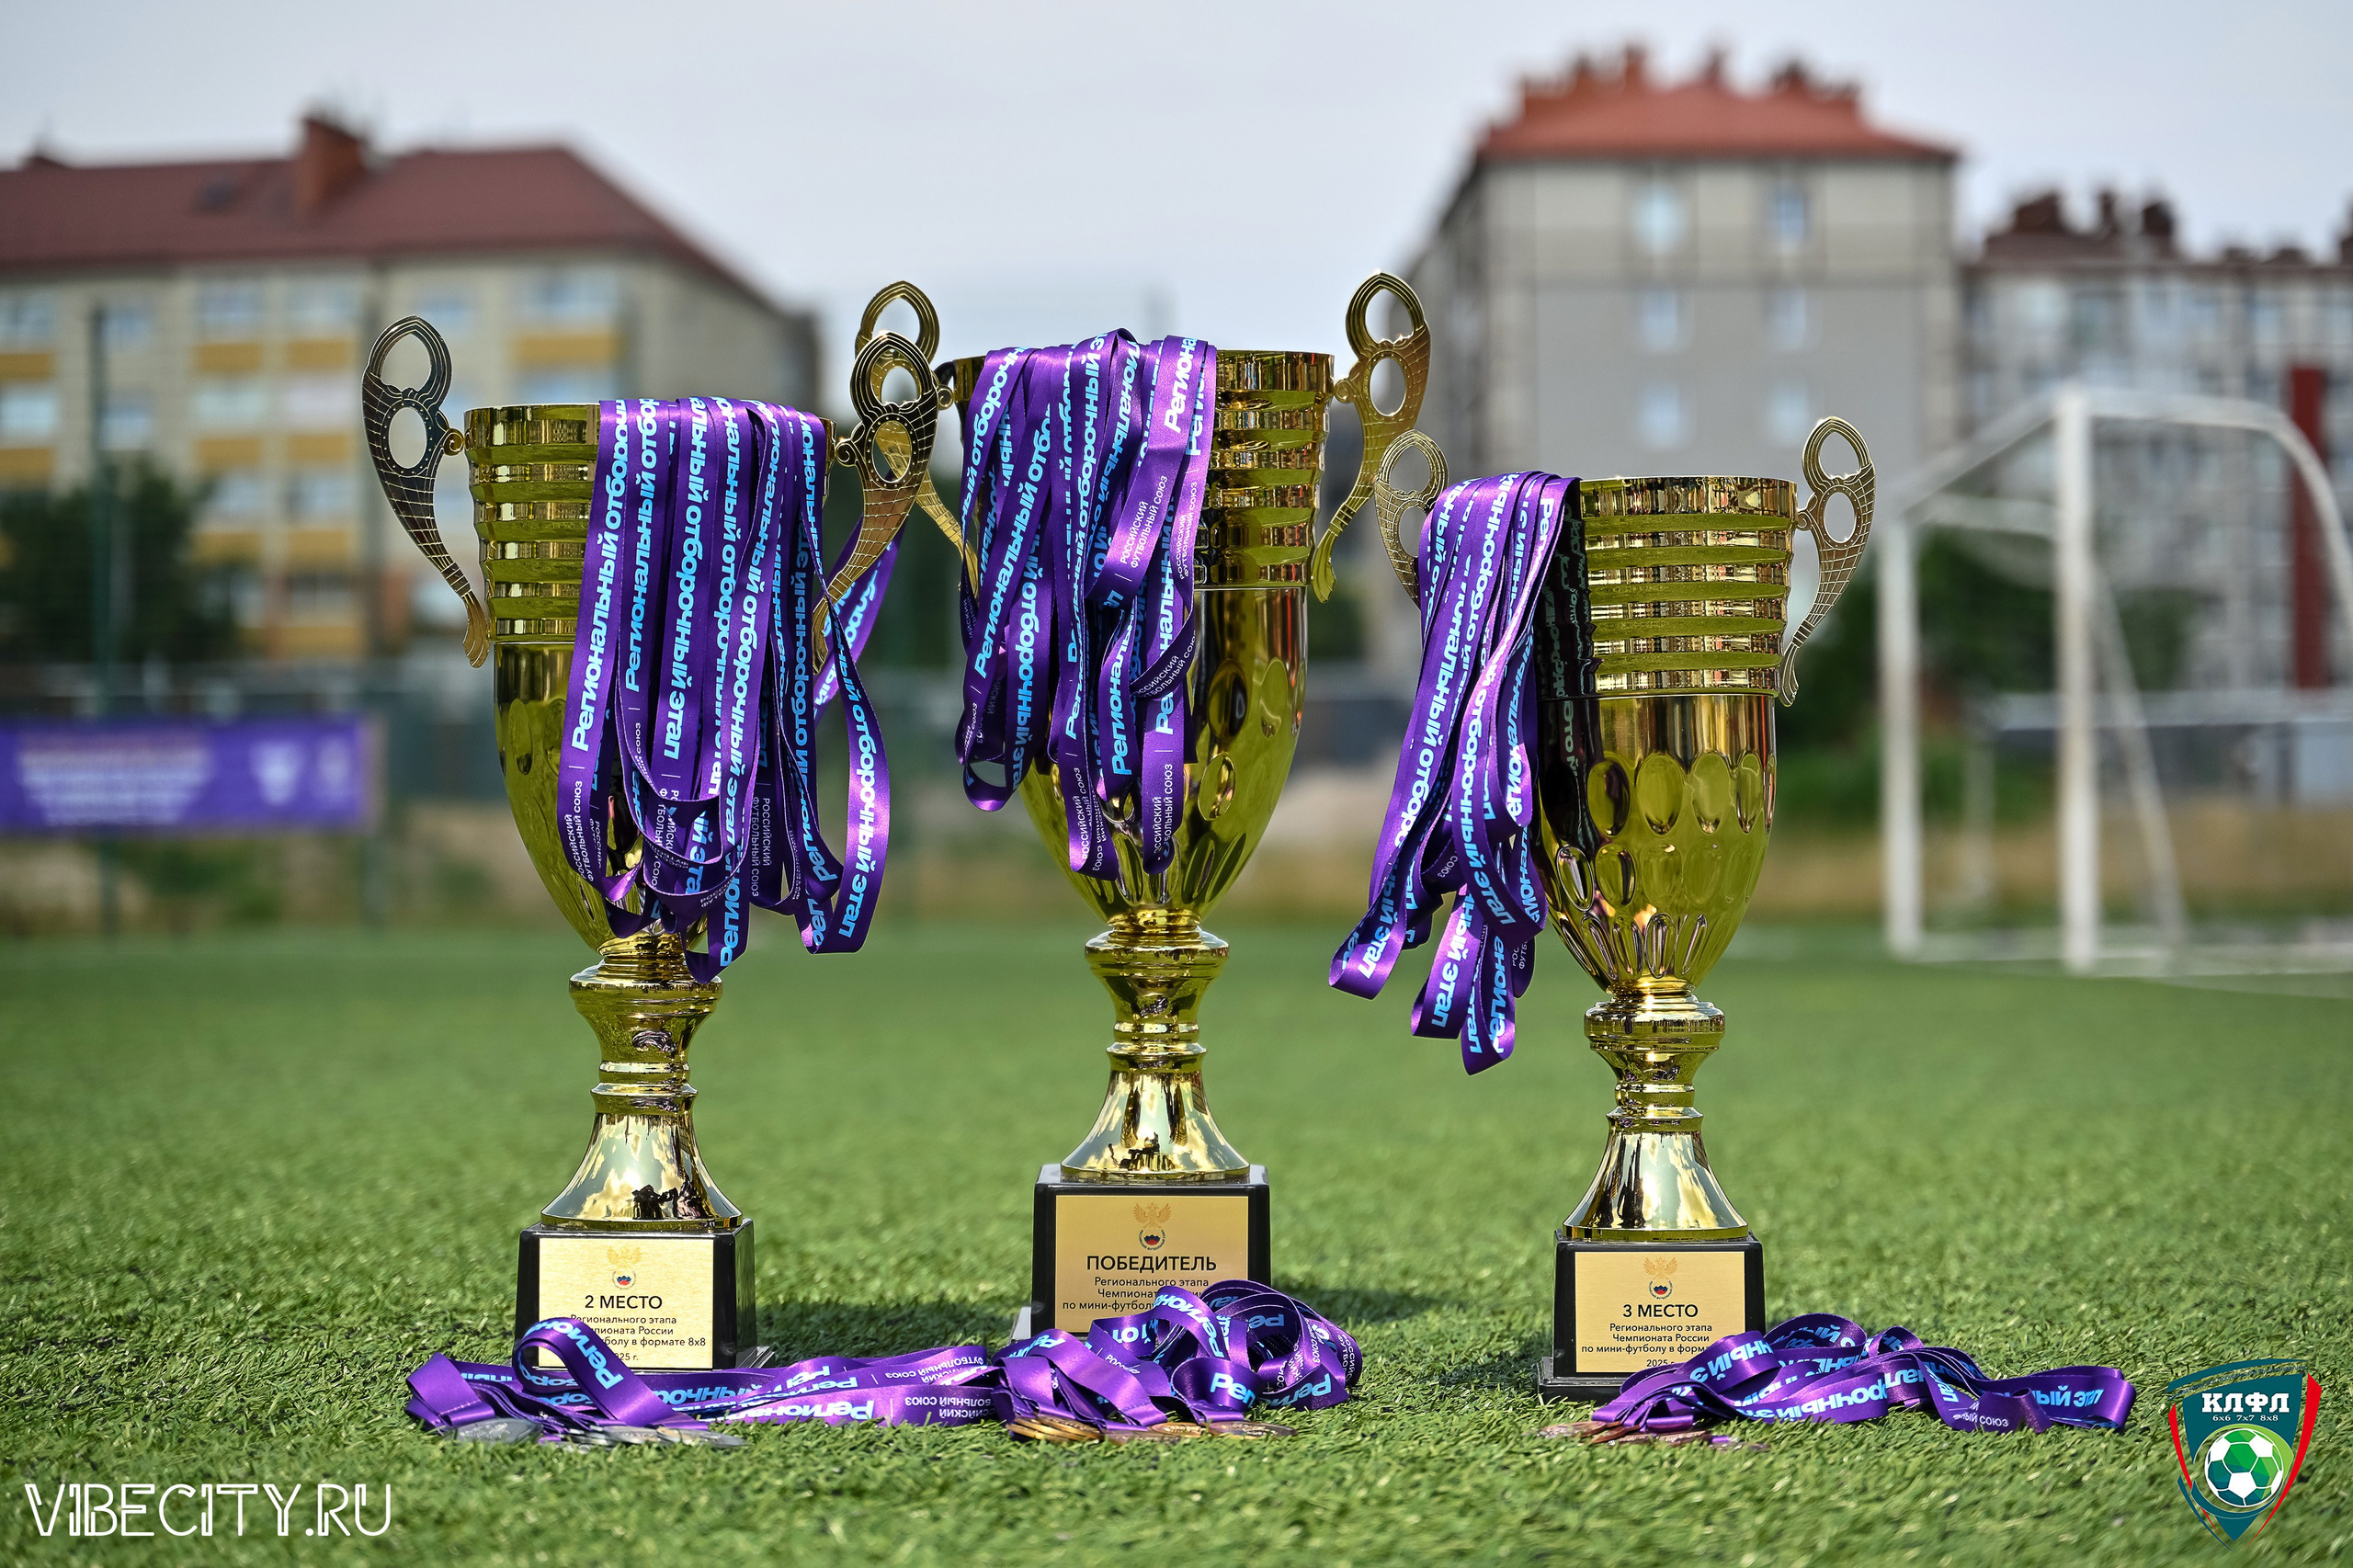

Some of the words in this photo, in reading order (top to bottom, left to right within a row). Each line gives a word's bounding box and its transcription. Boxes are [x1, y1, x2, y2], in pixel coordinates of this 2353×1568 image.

[1165, 338, 1198, 434] Региона
[1078, 352, 1101, 528] отборочный
[1120, 501, 1148, 564] РОССИЙСКИЙ
[1131, 505, 1159, 568] ФУТБОЛЬНЫЙ
[1154, 475, 1167, 505] СОЮЗ
[1181, 511, 1195, 577] ФУТБОЛЬНЫЙ
[1176, 515, 1187, 580] РОССИЙСКИЙ
[1466, 472, 1520, 642] отборочный
[626, 471, 657, 692] Региональный
[671, 505, 703, 689] отборочный
[974, 482, 1039, 679] Региональный
[572, 530, 620, 752] Региональный
[790, 572, 810, 746] отборочный
[1014, 582, 1040, 744] отборочный
[1184, 631, 1195, 659] СОЮ
[730, 595, 758, 776] отборочный
[664, 690, 686, 760] этап
[1506, 632, 1534, 824] егиональный
[851, 704, 878, 873] отборочный
[1012, 746, 1026, 791] эта
[1074, 767, 1086, 795] СОЮЗ
[1165, 764, 1174, 795] СОЮЗ
[574, 780, 583, 813] СОЮЗ
[725, 777, 739, 846] этап
[1165, 796, 1174, 842] БОЛЬНЫЙ
[1460, 688, 1487, 869] отборочный
[1474, 870, 1517, 926] этап
[751, 797, 760, 867] ФУТБОЛЬНЫЙ
[762, 798, 772, 866] РОССИЙСКИЙ
[1073, 795, 1089, 860] РОССИЙСКИЙ
[1154, 796, 1162, 854] ОССИЙСКИЙ
[1093, 845, 1103, 871] СОЮЗ
[1438, 855, 1459, 878] СОЮЗ
[750, 869, 759, 897] СОЮЗ
[838, 874, 867, 937] этап
[1358, 926, 1391, 980] этап
[1431, 961, 1459, 1028] этап
[1086, 1256, 1217, 1274] ПОБЕДИТЕЛЬ
[1094, 1277, 1176, 1287] Регионального
[1178, 1278, 1209, 1287] этапа
[585, 1295, 595, 1309] 2
[600, 1295, 663, 1310] МЕСТО
[1063, 1301, 1076, 1310] по
[1097, 1289, 1158, 1299] Чемпионат
[1622, 1304, 1632, 1318] 3
[1638, 1304, 1699, 1318] МЕСТО
[638, 1326, 674, 1335] России
[641, 1336, 686, 1348] формате
[1596, 1345, 1666, 1355] мини-футболу
[1677, 1344, 1709, 1355] форм
[1609, 1324, 1684, 1332] Регионального
[1612, 1334, 1673, 1342] Чемпионата
[1676, 1333, 1710, 1342] России
[615, 1353, 631, 1361] 025
[885, 1369, 917, 1379] СОЮЗ
[917, 1356, 983, 1377] ФУТБОЛЬНЫЙ
[1311, 1340, 1321, 1363] СОЮЗ
[904, 1396, 938, 1406] СОЮЗ
[1979, 1415, 2009, 1427] СОЮЗ
[2074, 1388, 2105, 1408] этап
